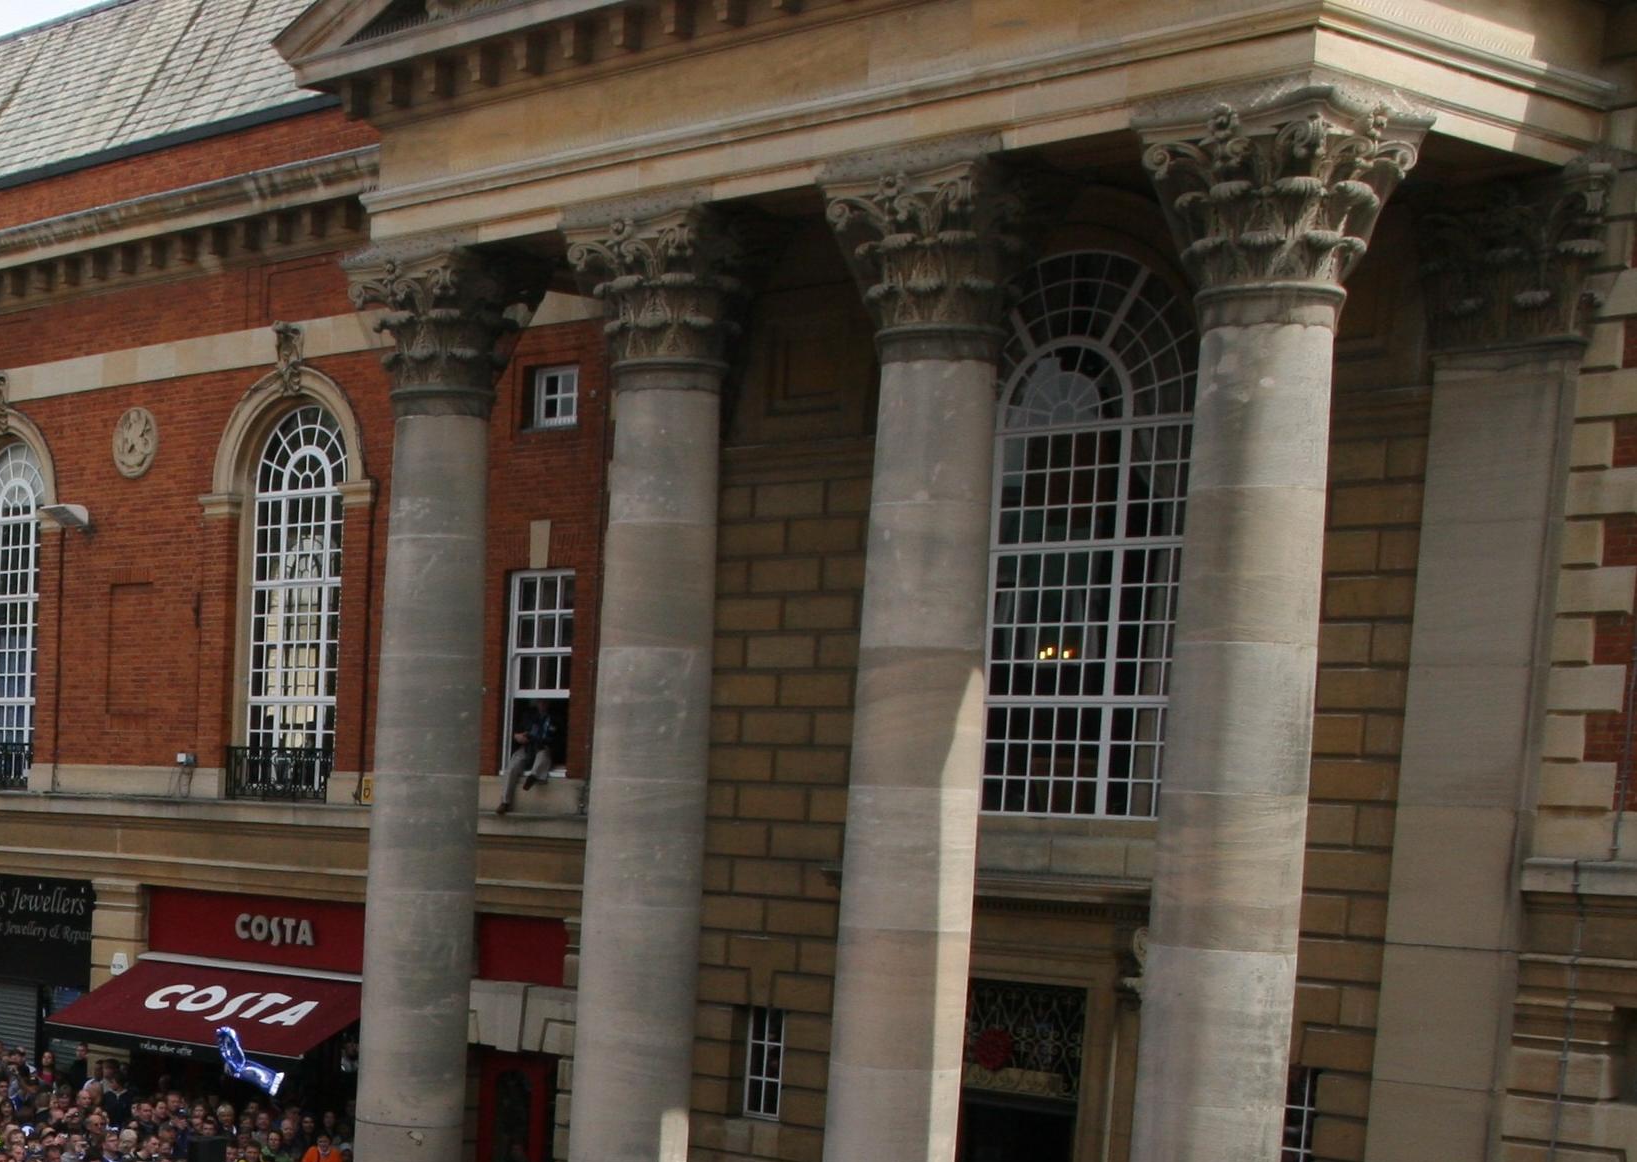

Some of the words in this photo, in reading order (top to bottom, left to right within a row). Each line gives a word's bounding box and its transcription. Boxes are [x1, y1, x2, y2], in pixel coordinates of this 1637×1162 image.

[8, 886, 87, 915] Jewellers
[4, 921, 48, 941] Jewellery
[235, 913, 315, 946] COSTA
[144, 984, 319, 1026] COSTA
